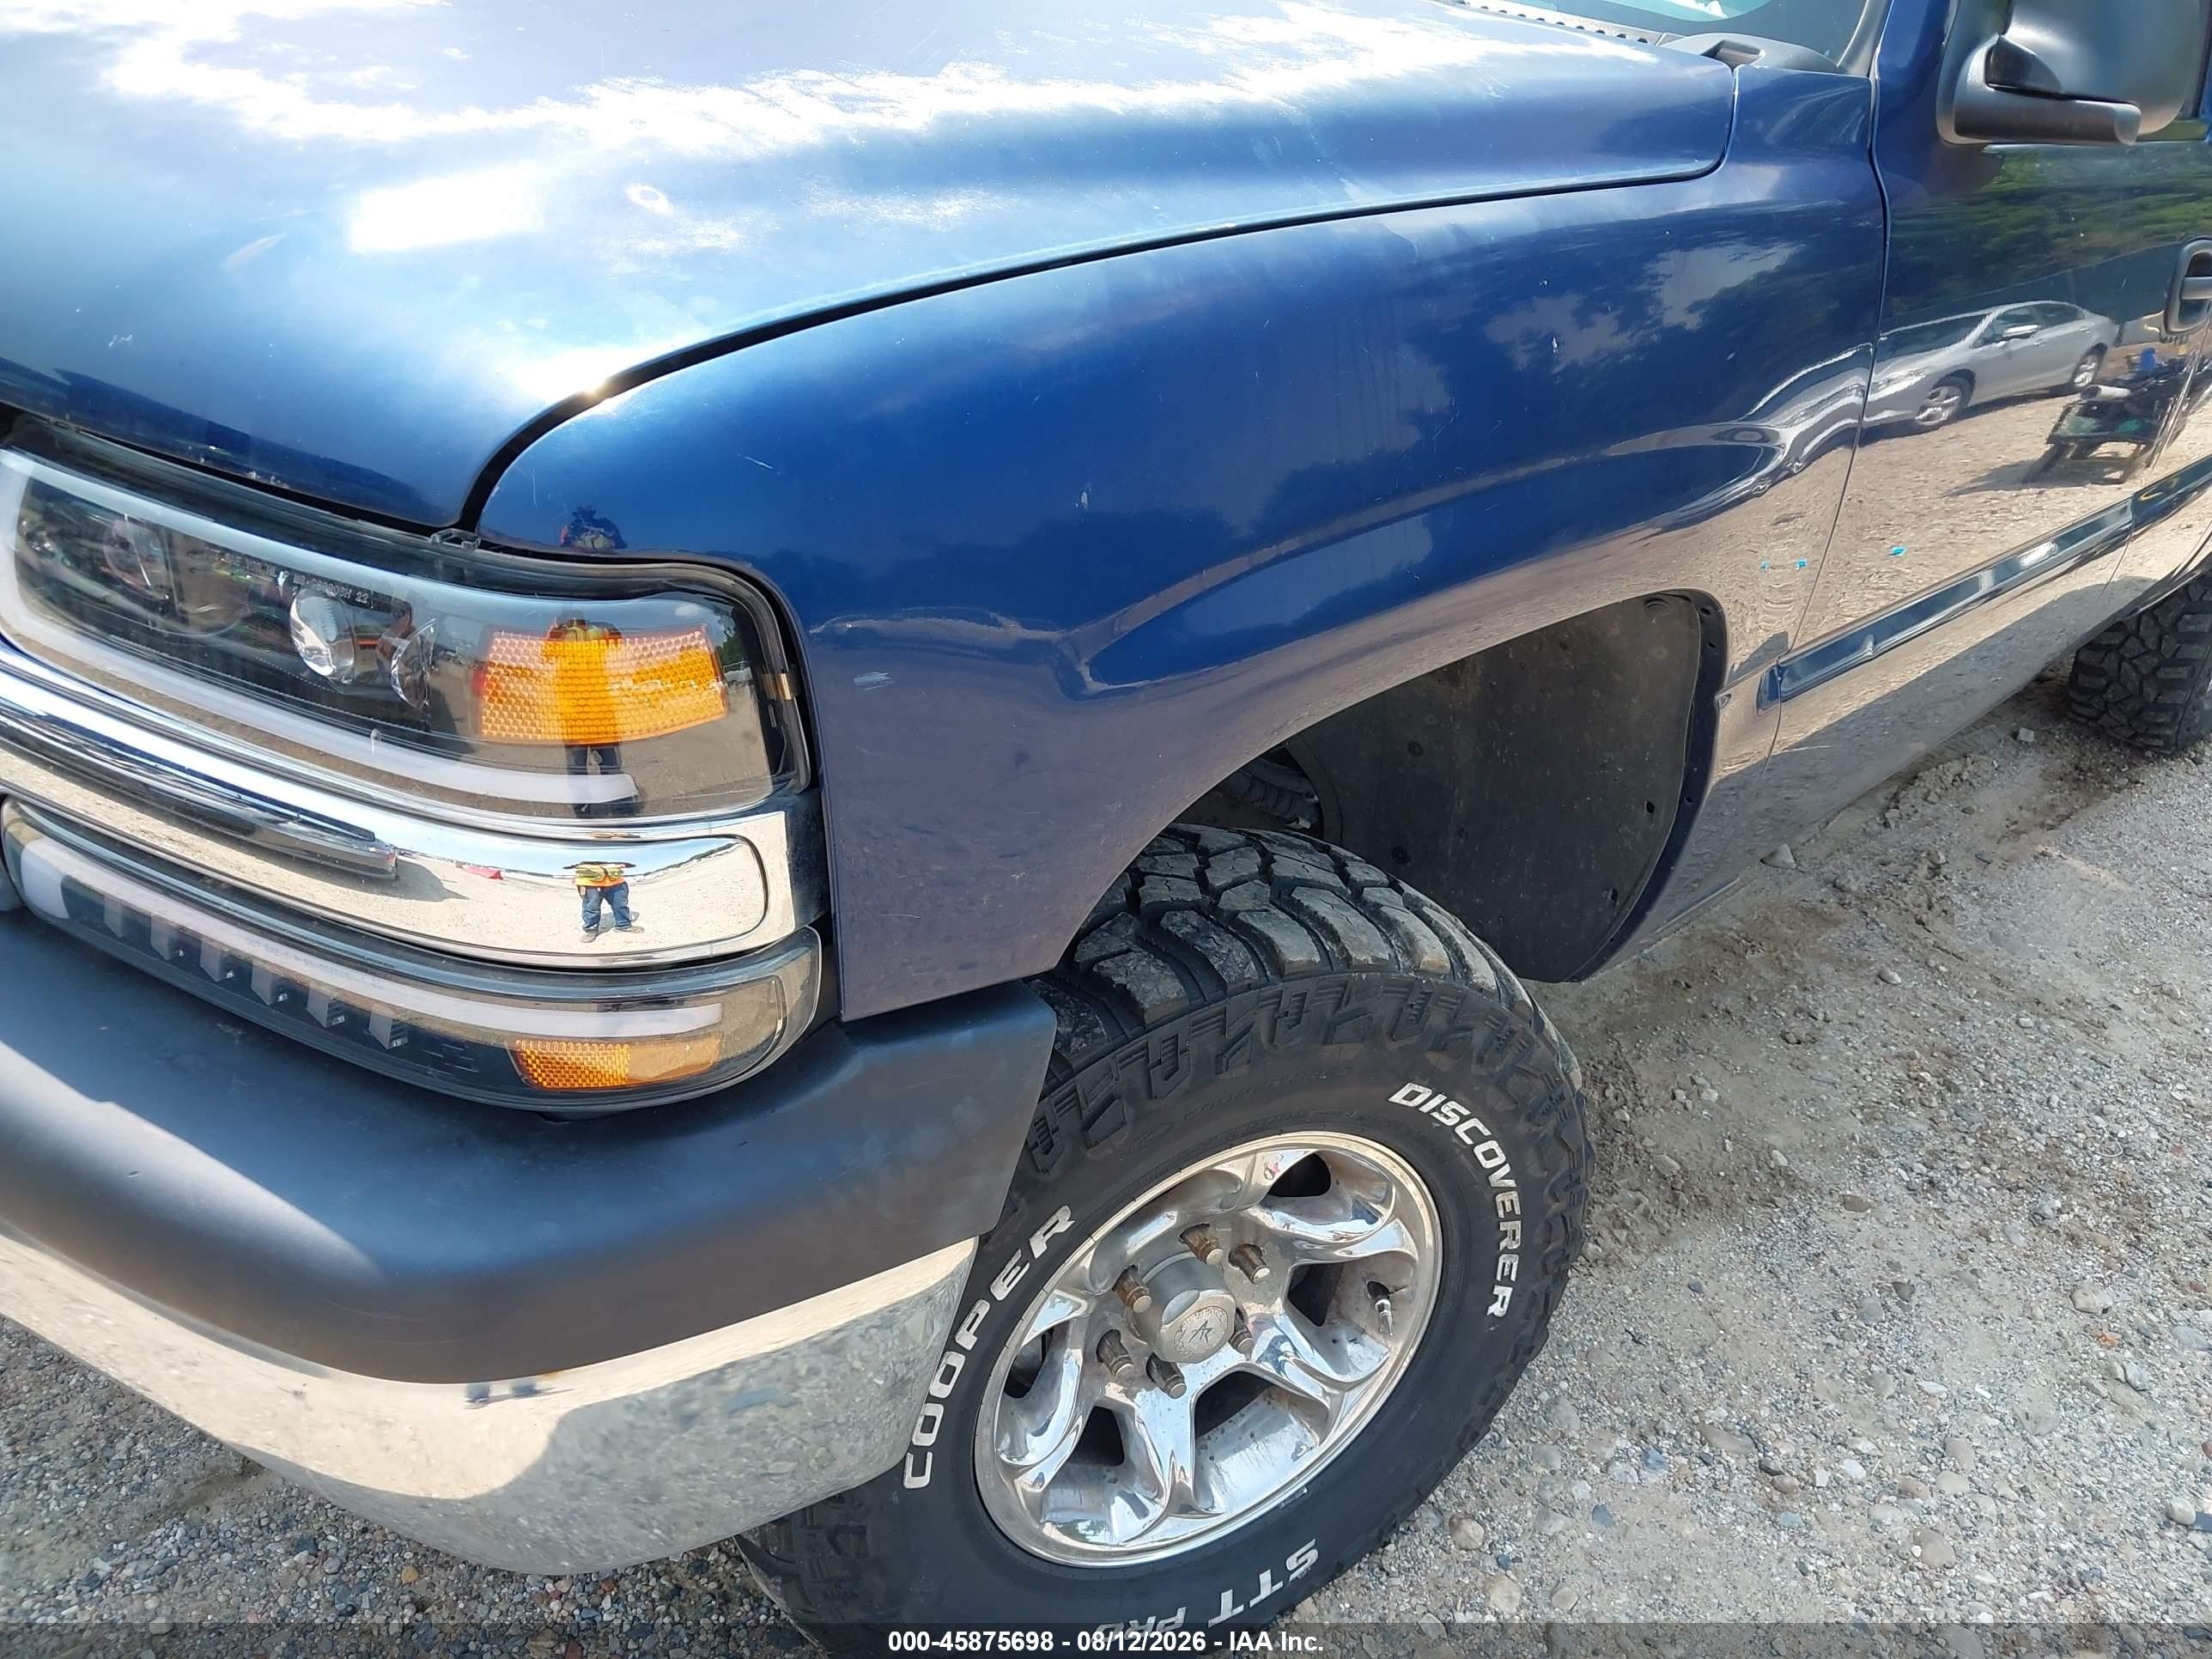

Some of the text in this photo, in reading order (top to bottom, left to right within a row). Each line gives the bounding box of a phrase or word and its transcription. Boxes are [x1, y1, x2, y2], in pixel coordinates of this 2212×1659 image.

[1388, 1082, 1522, 1318] DISCOVERER
[903, 1205, 1075, 1489] COOPER
[1092, 1538, 1319, 1643] STT PRO
